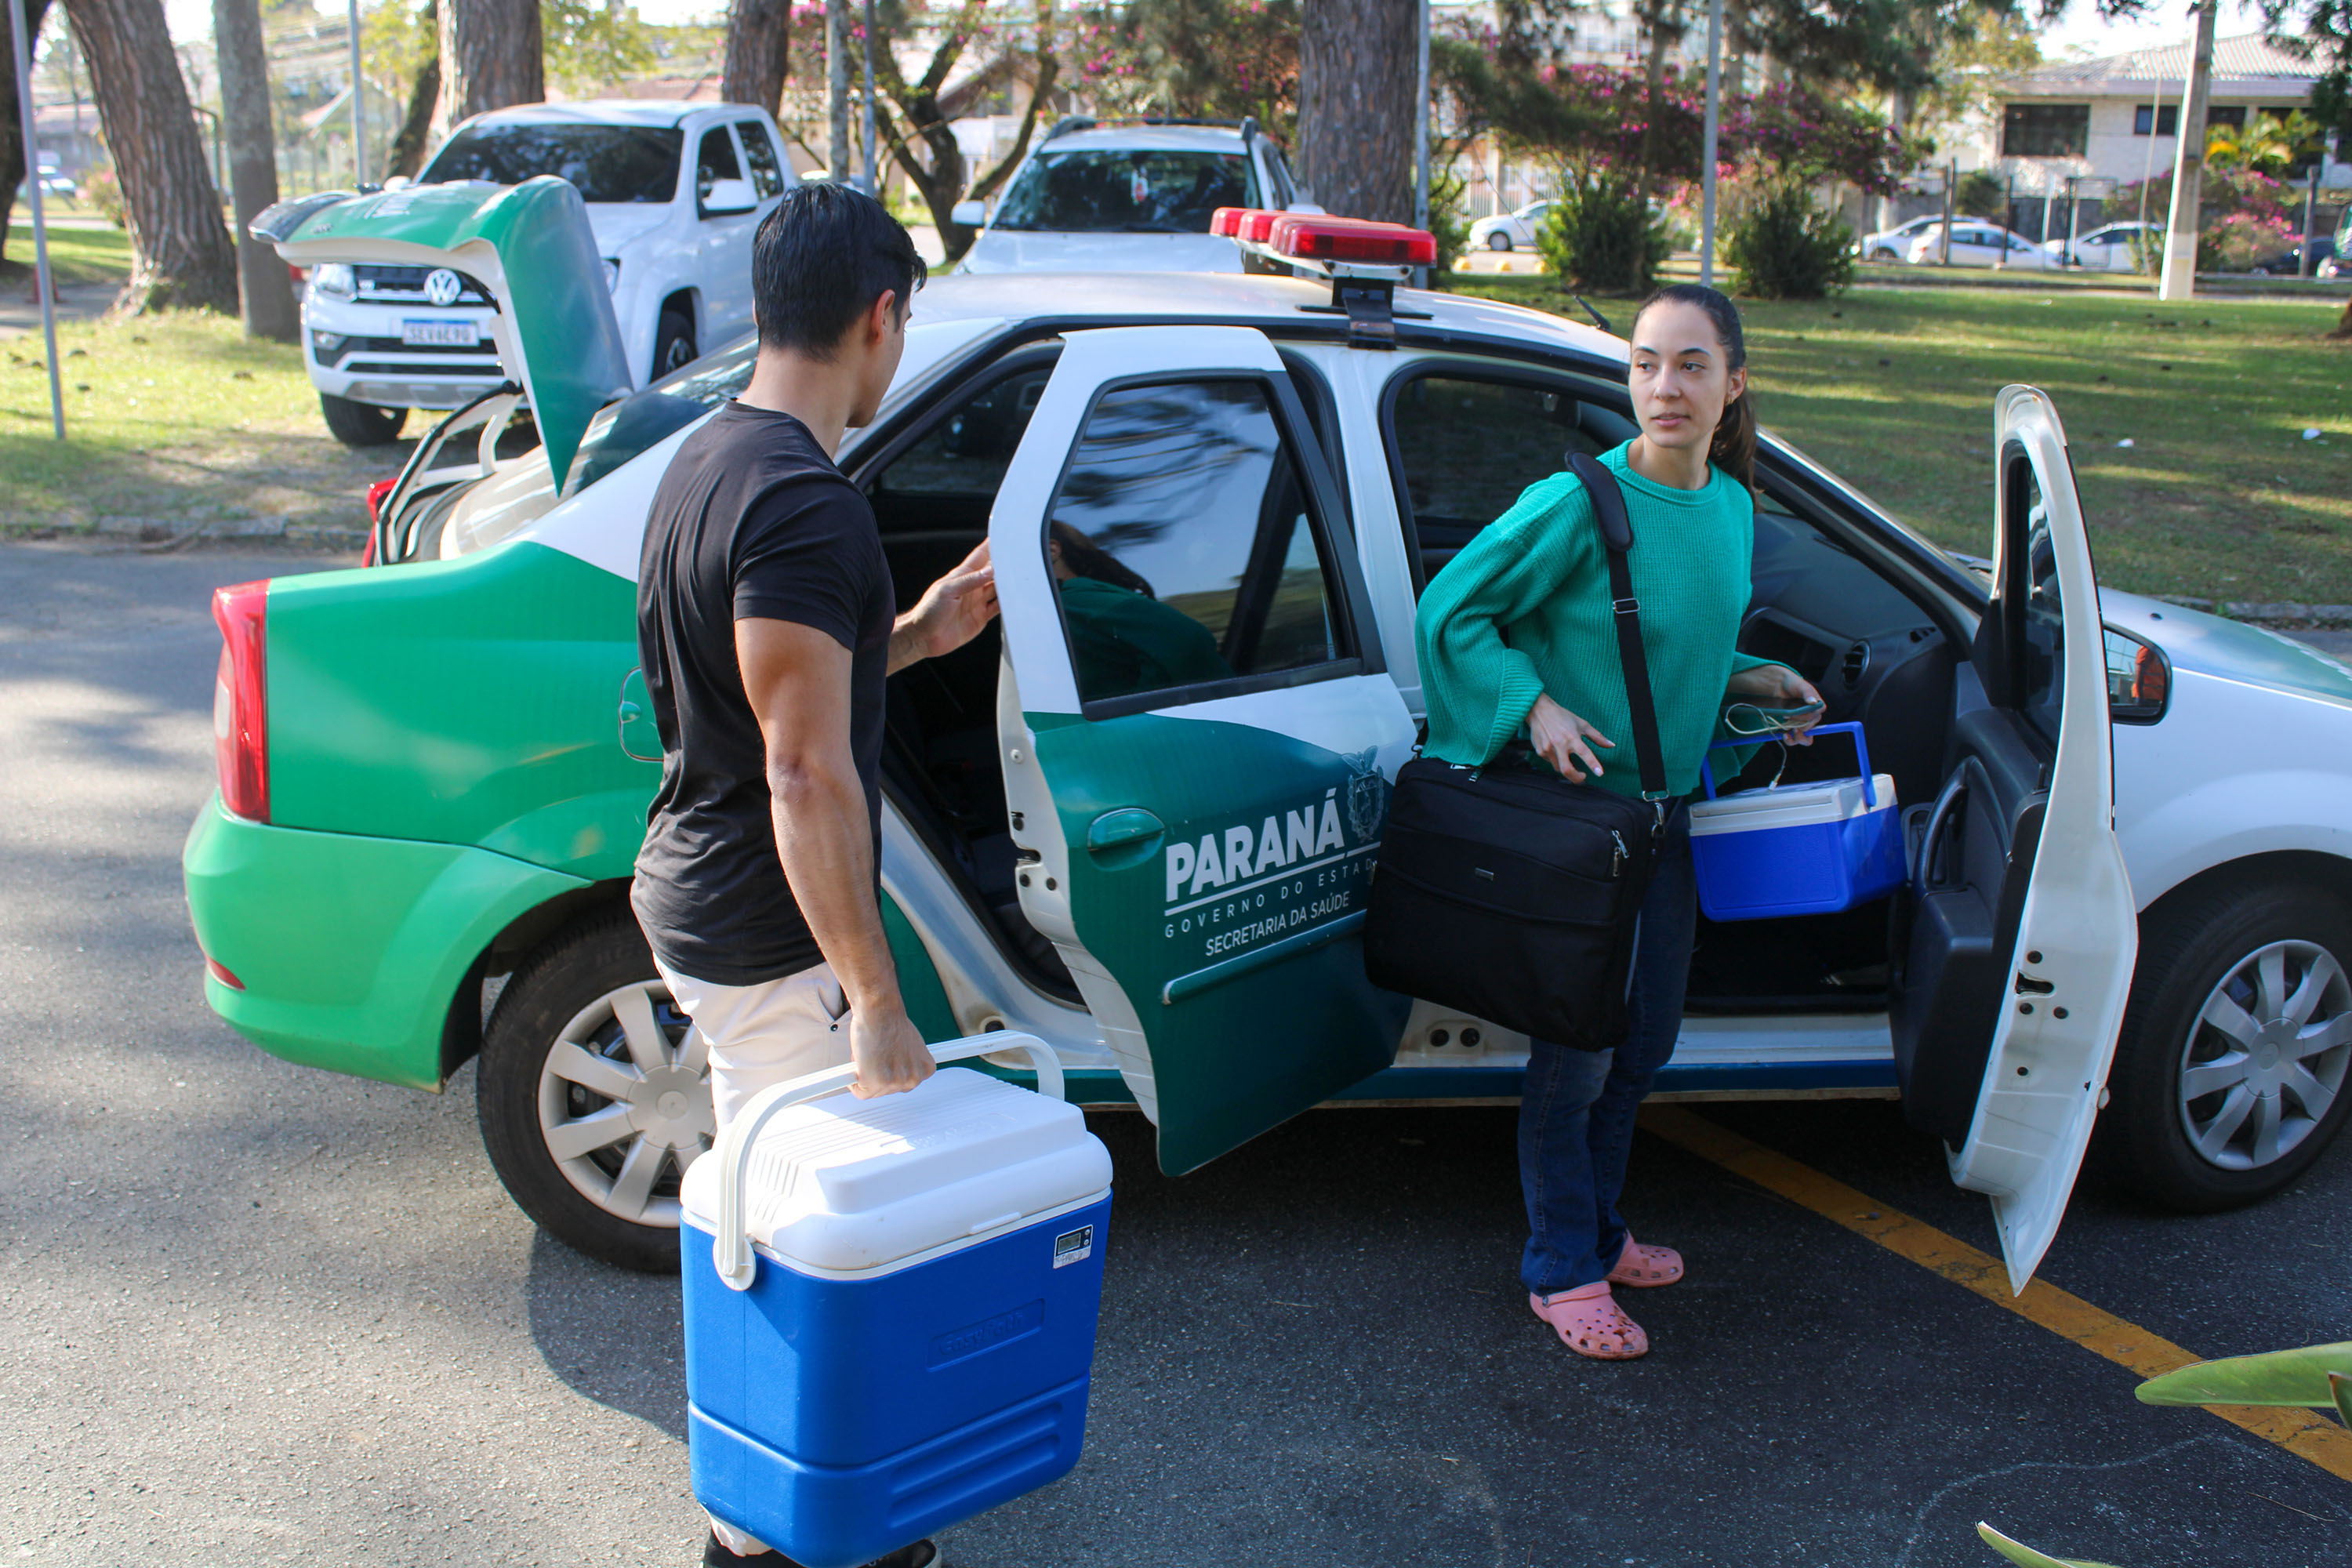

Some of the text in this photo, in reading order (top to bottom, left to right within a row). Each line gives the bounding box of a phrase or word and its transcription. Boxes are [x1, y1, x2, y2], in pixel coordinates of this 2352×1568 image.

[1165, 787, 1345, 903] PARANÁ
[1165, 858, 1372, 938] GOVERNO DO ESTAD
[1205, 891, 1350, 956] SECRETARIA DA SAÚDE
